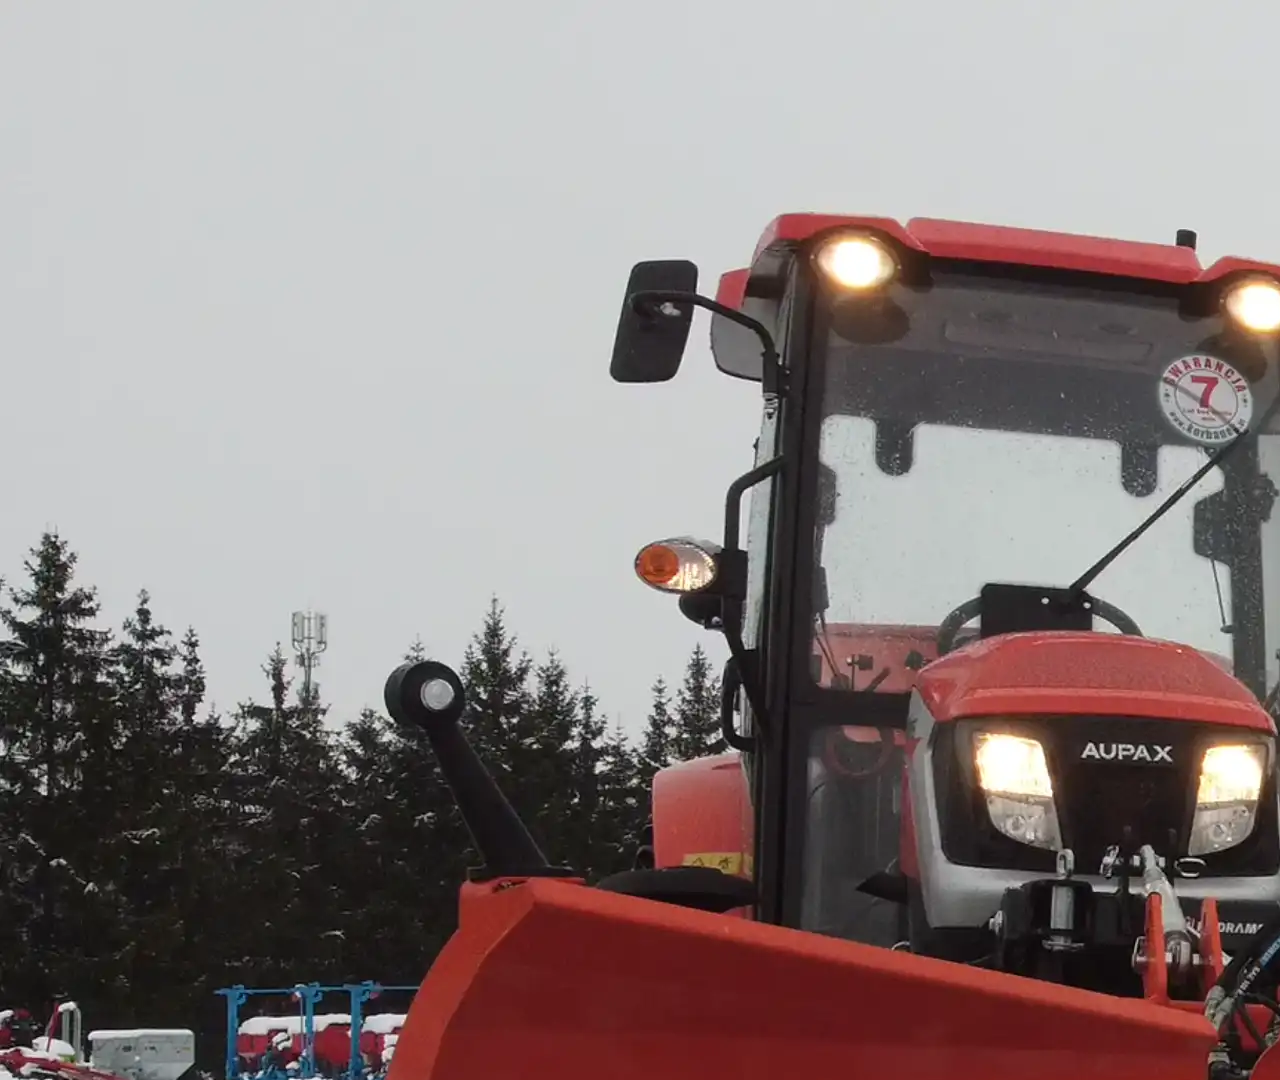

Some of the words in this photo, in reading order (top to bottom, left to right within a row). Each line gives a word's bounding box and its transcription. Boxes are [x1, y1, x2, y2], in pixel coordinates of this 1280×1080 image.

[1163, 356, 1247, 393] GWARANCJA
[1190, 374, 1219, 408] 7
[1080, 741, 1174, 762] AUPAX
